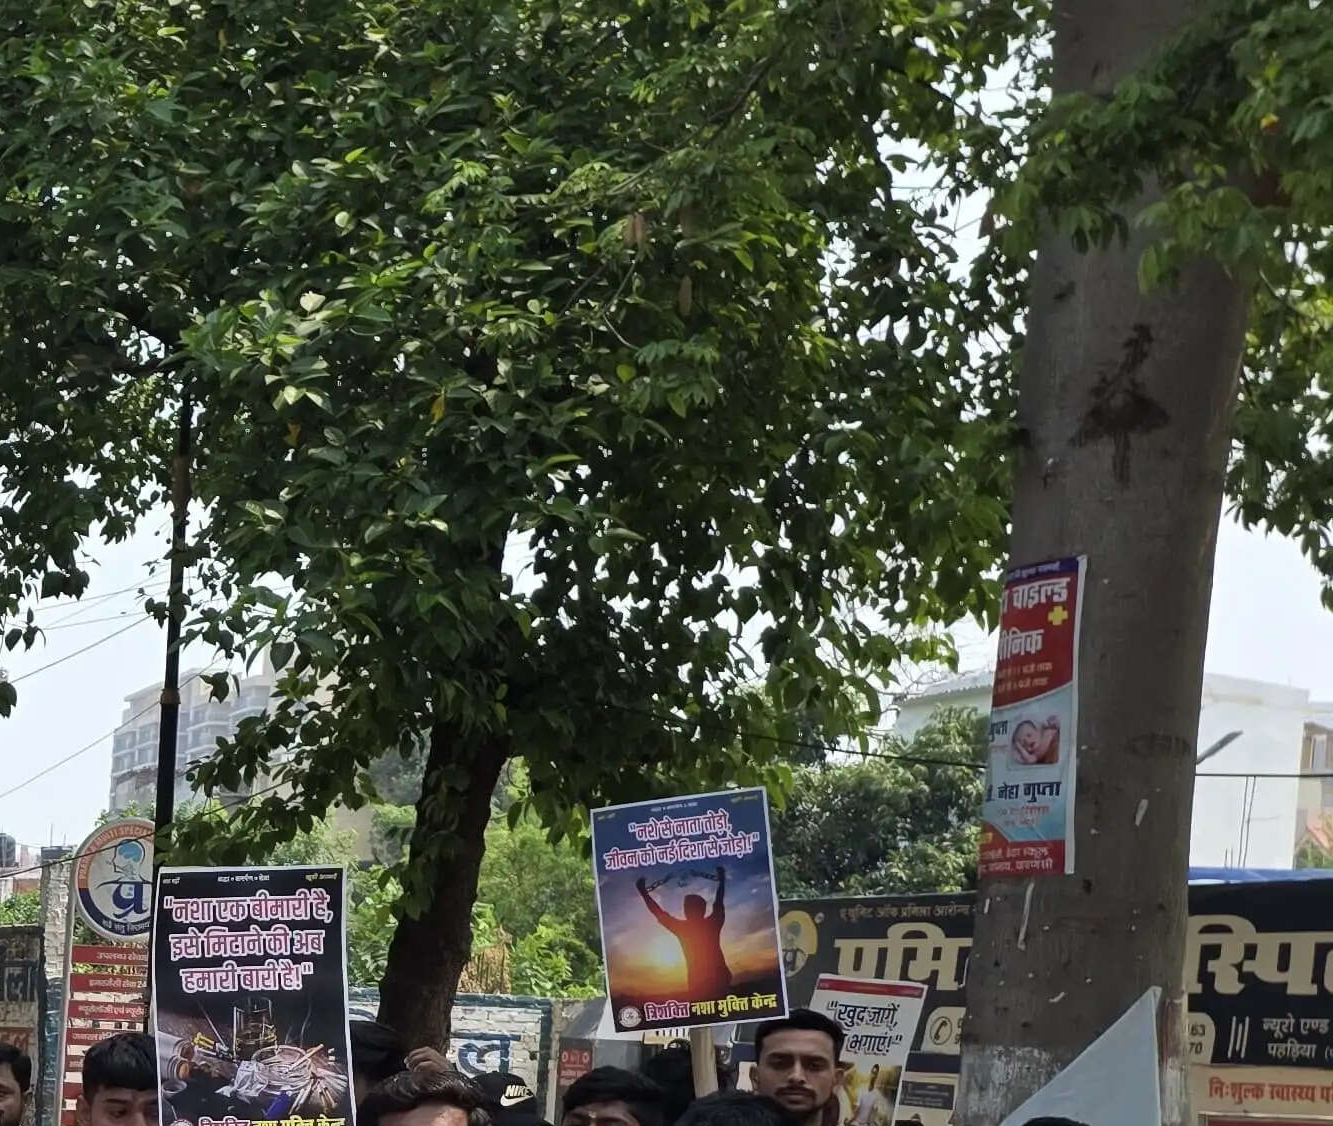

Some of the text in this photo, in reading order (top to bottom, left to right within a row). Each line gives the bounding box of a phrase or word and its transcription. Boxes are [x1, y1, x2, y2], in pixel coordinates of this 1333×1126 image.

[660, 817, 674, 838] से
[674, 818, 702, 836] नाता
[604, 846, 639, 870] जीवन
[638, 842, 657, 866] को
[678, 837, 707, 862] दिशा
[705, 835, 721, 860] से
[164, 888, 333, 923] "नशा एक बीमारी है,
[169, 924, 325, 960] इसे मिटाने की अब
[180, 959, 313, 993] हमारी बारी है!"
[504, 1085, 531, 1097] NIKE
